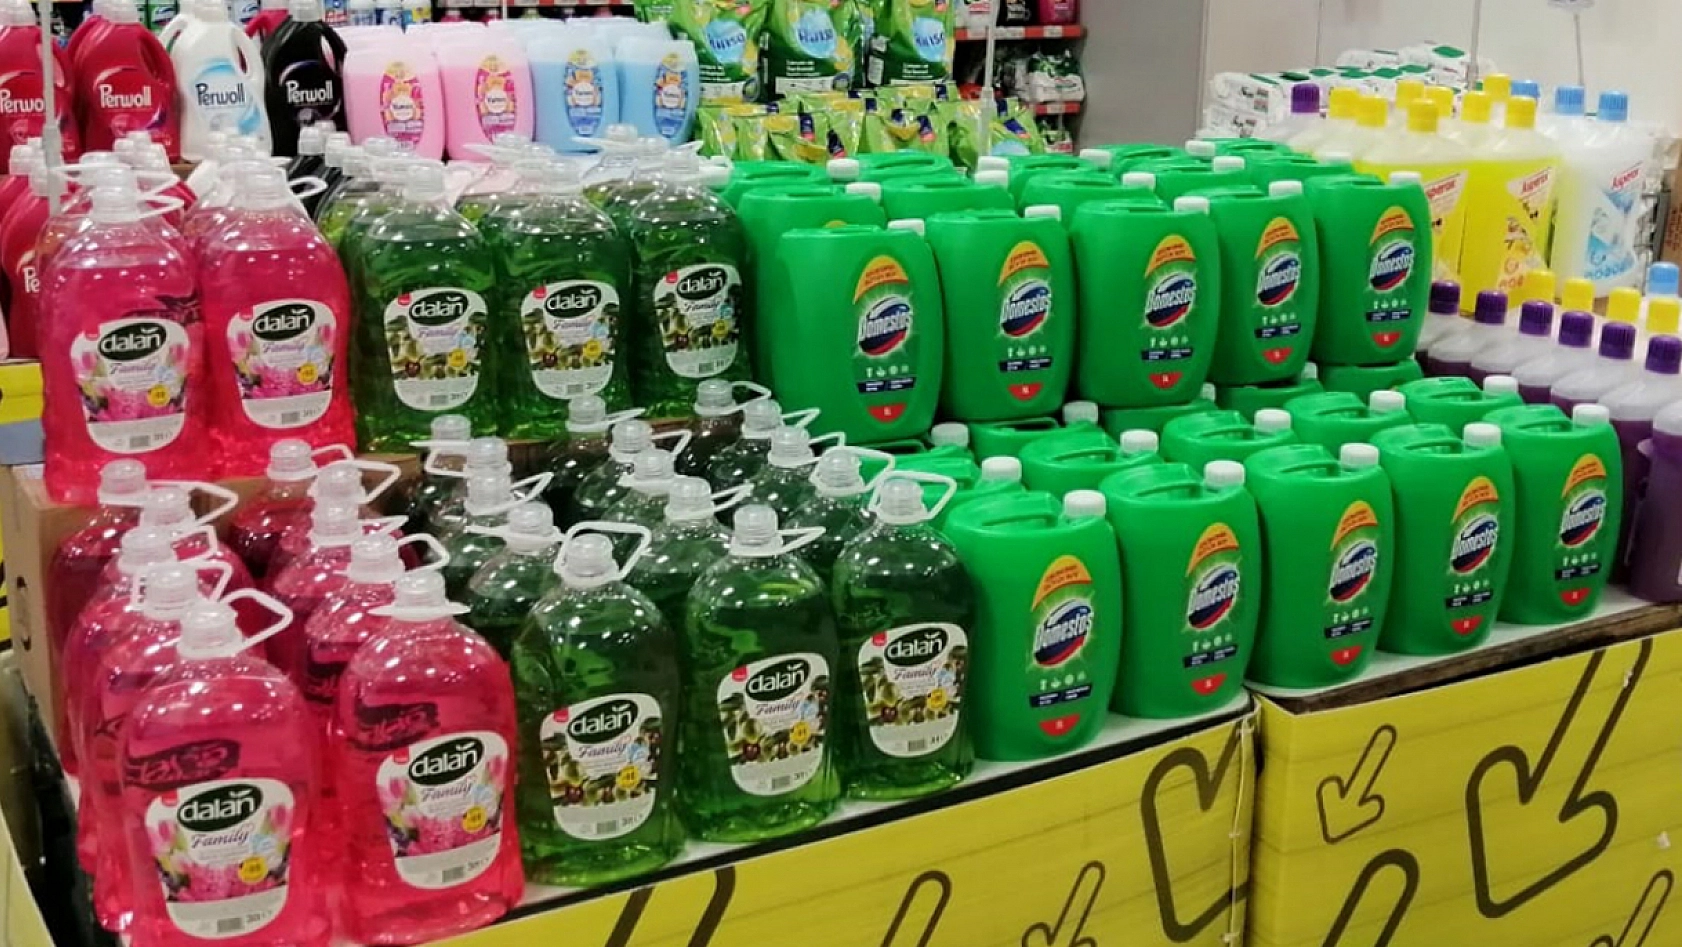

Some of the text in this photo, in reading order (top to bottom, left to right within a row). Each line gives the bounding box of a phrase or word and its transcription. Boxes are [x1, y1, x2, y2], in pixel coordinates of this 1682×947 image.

[0, 89, 44, 113] Perwo
[100, 84, 152, 108] Perwoll
[195, 82, 245, 106] Perwoll
[285, 79, 333, 104] Perwoll
[1002, 293, 1051, 321] Domestos
[1147, 284, 1196, 312] Domestos
[858, 309, 913, 338] Domestos
[1332, 556, 1377, 583] Domestos
[1189, 576, 1241, 611] Domestos
[1036, 612, 1094, 648] Domestos
[421, 782, 472, 802] Family
[191, 828, 250, 849] Family
